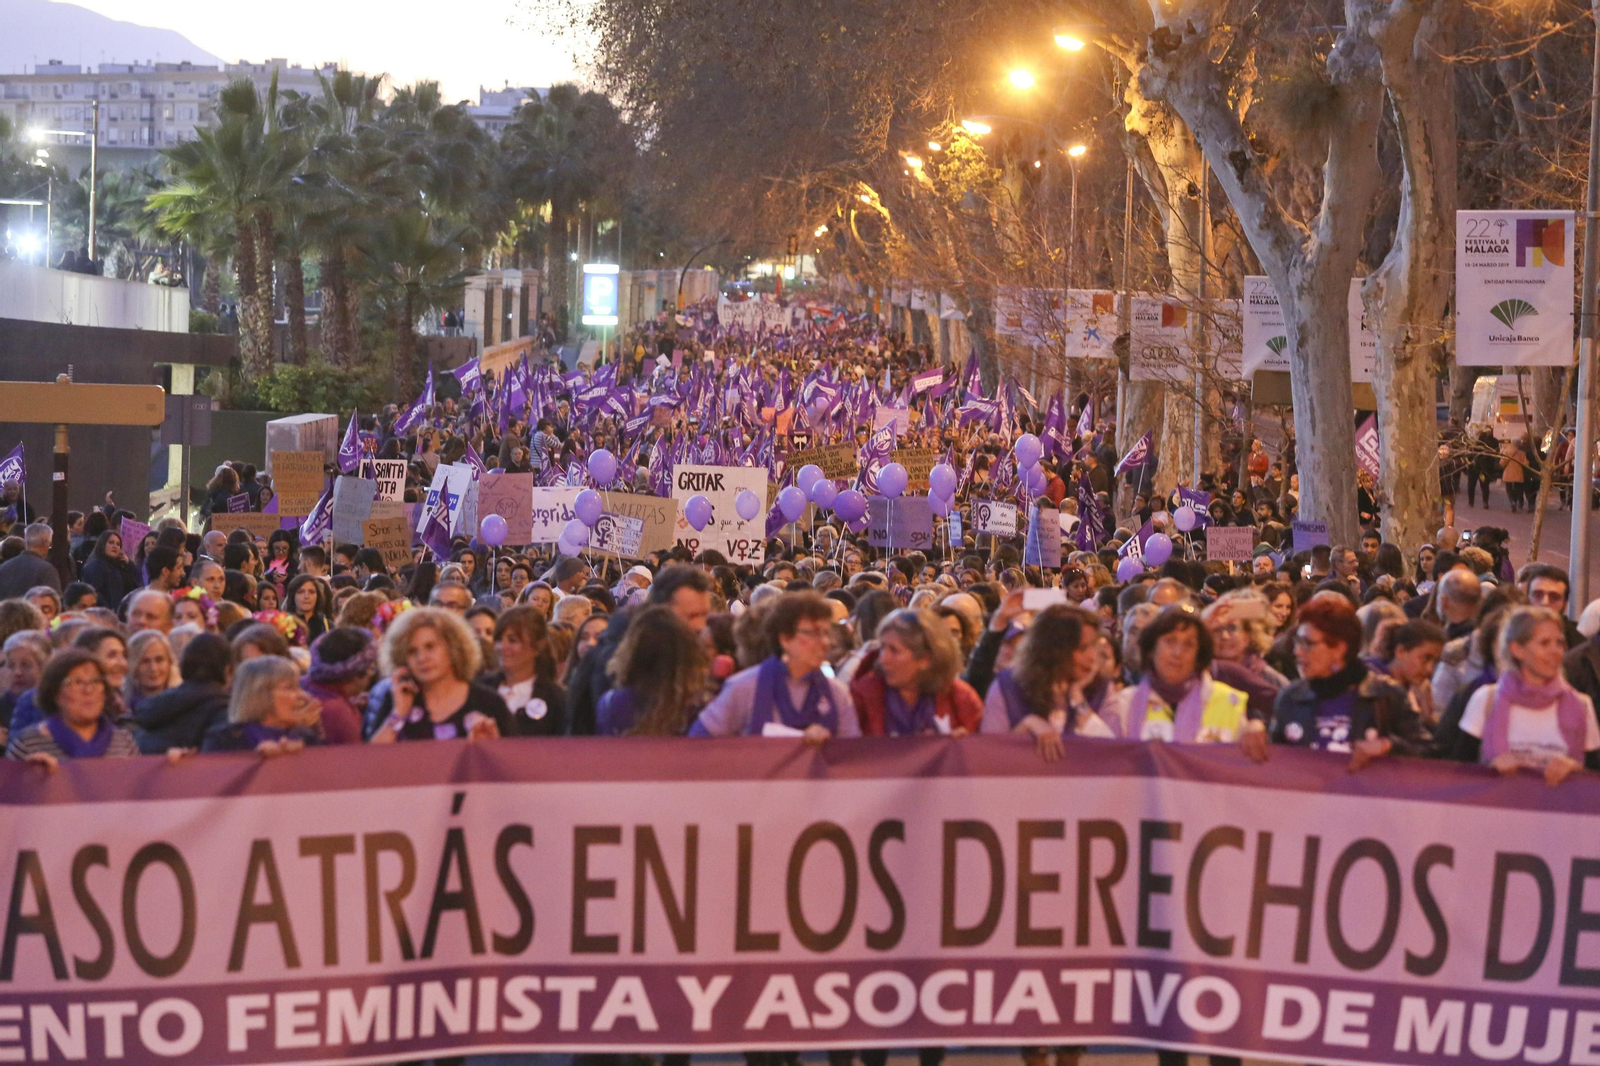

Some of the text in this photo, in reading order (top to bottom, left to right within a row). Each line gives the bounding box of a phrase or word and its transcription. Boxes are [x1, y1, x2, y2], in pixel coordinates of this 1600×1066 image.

[1466, 218, 1491, 238] 22
[590, 277, 614, 305] P
[1250, 281, 1268, 294] 22
[1489, 334, 1517, 343] Unicaja
[375, 461, 404, 479] SANTA
[678, 471, 725, 491] GRITAR
[873, 528, 888, 541] NO
[227, 791, 535, 973] ATRÁS
[571, 825, 699, 955] EN
[735, 819, 906, 954] LOS
[940, 820, 1454, 977] DERECHOS
[227, 974, 659, 1053] FEMINISTA
[676, 976, 732, 1031] Y
[744, 969, 1241, 1034] ASOCIATIVO
[1261, 984, 1374, 1049] DE
